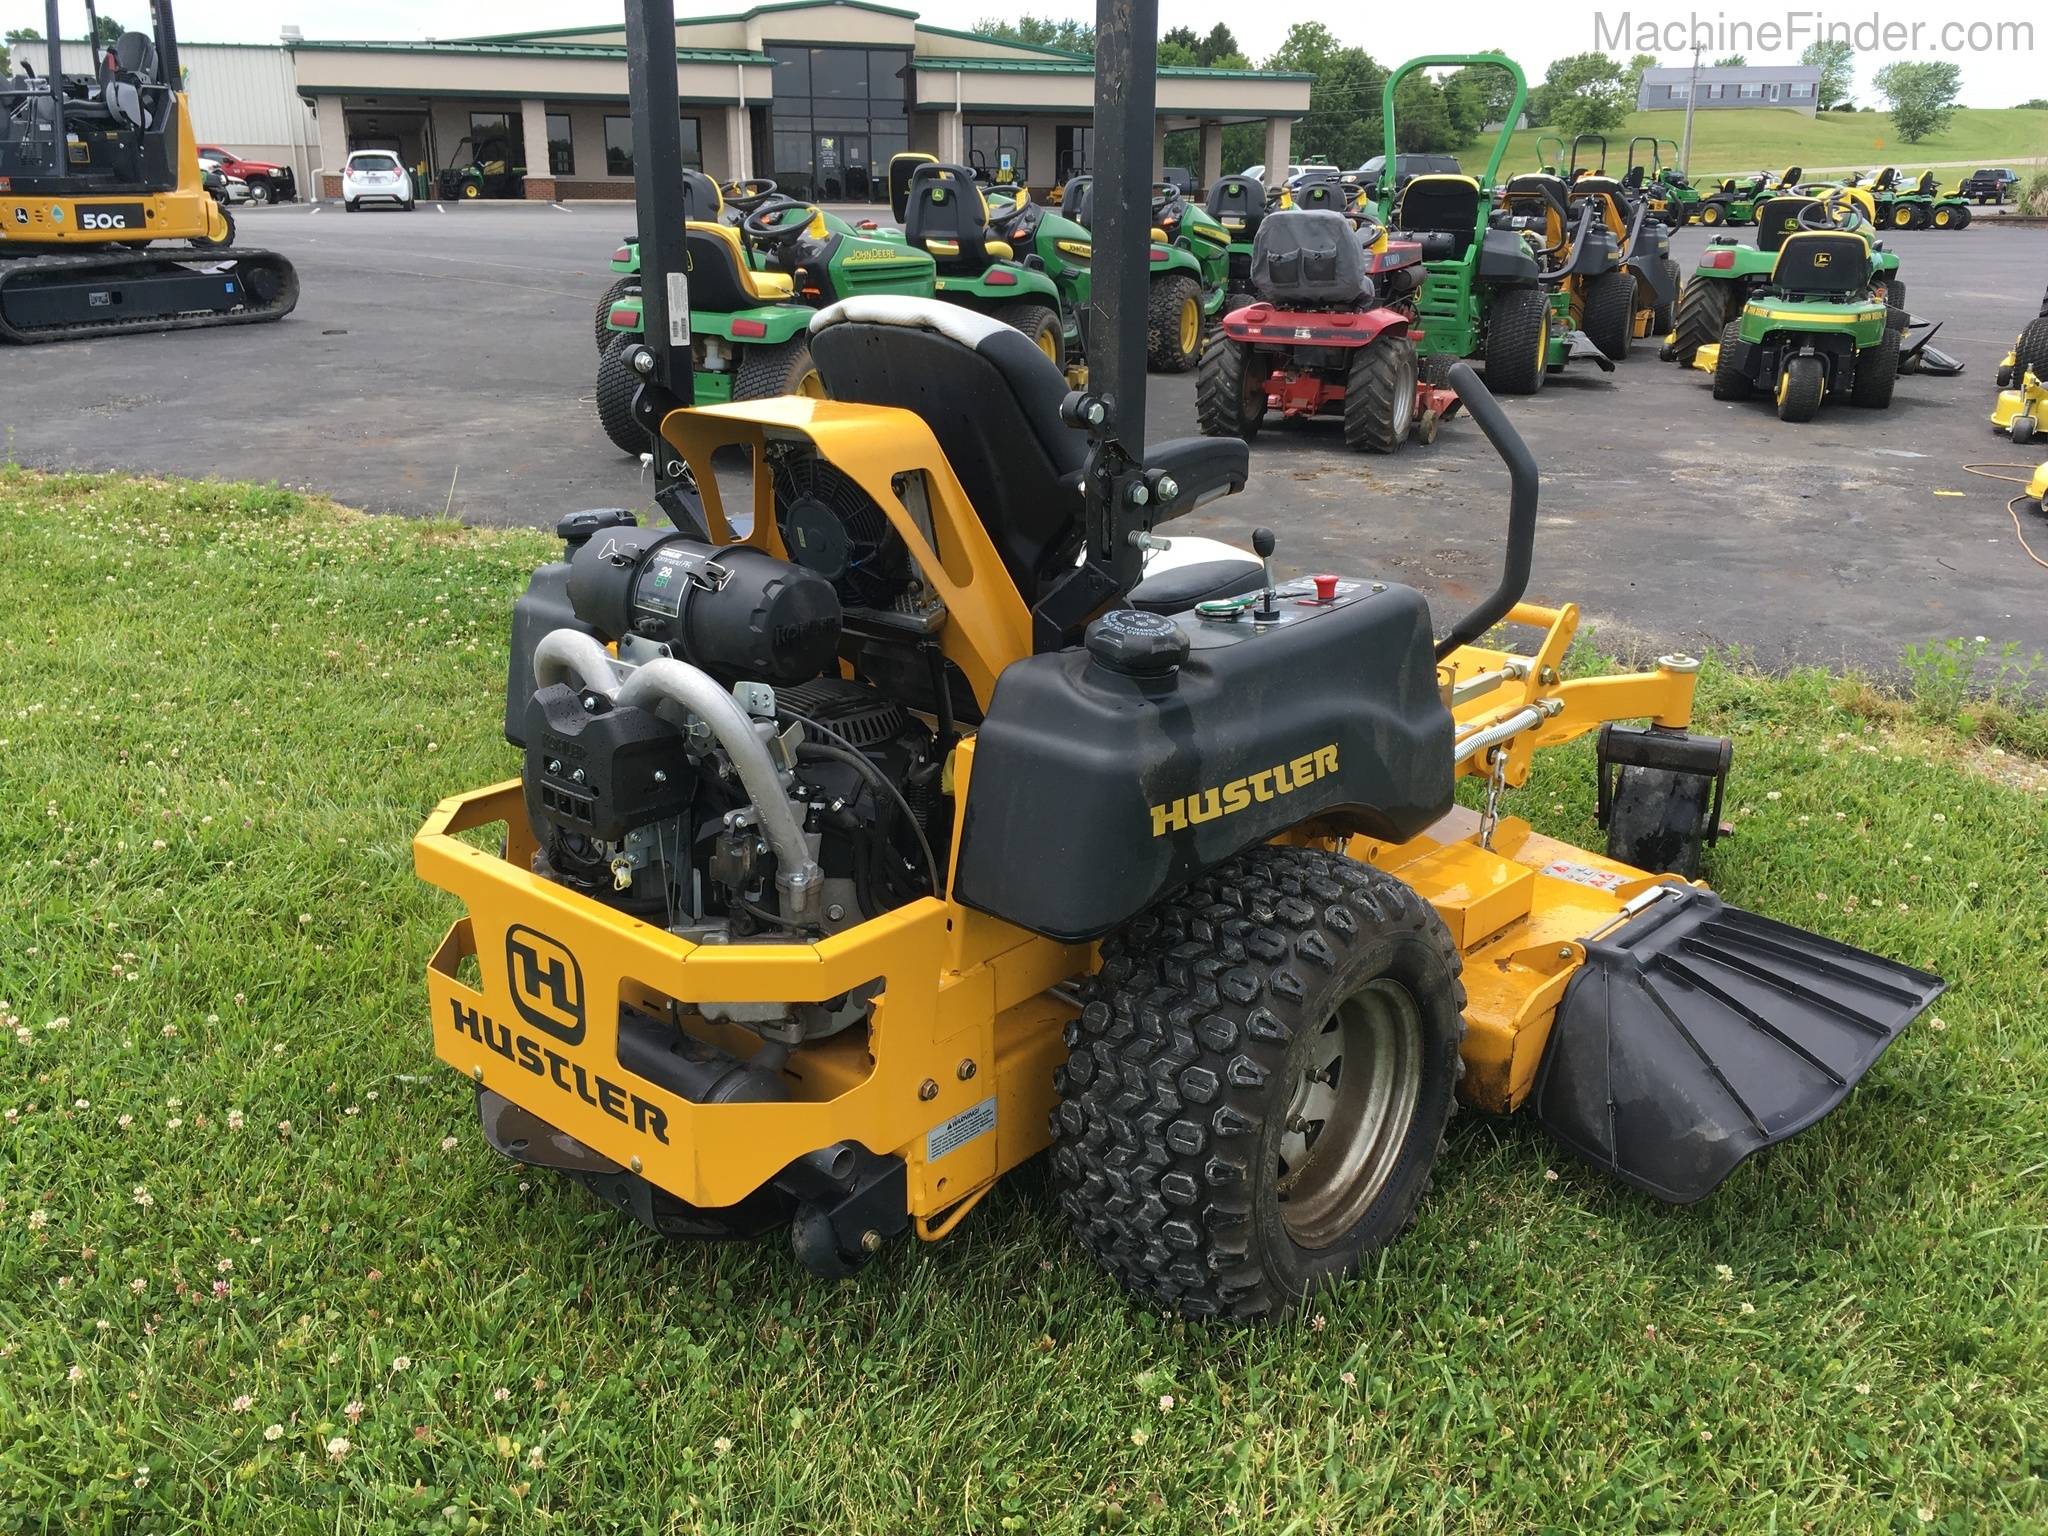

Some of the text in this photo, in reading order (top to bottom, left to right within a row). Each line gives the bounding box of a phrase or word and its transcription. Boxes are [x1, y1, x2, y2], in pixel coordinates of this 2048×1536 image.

[83, 213, 126, 229] 50G
[851, 248, 896, 260] JOHN DEERE
[654, 575, 669, 589] EFI
[1150, 744, 1338, 837] HUSTLER
[450, 997, 670, 1146] HUSTLER
